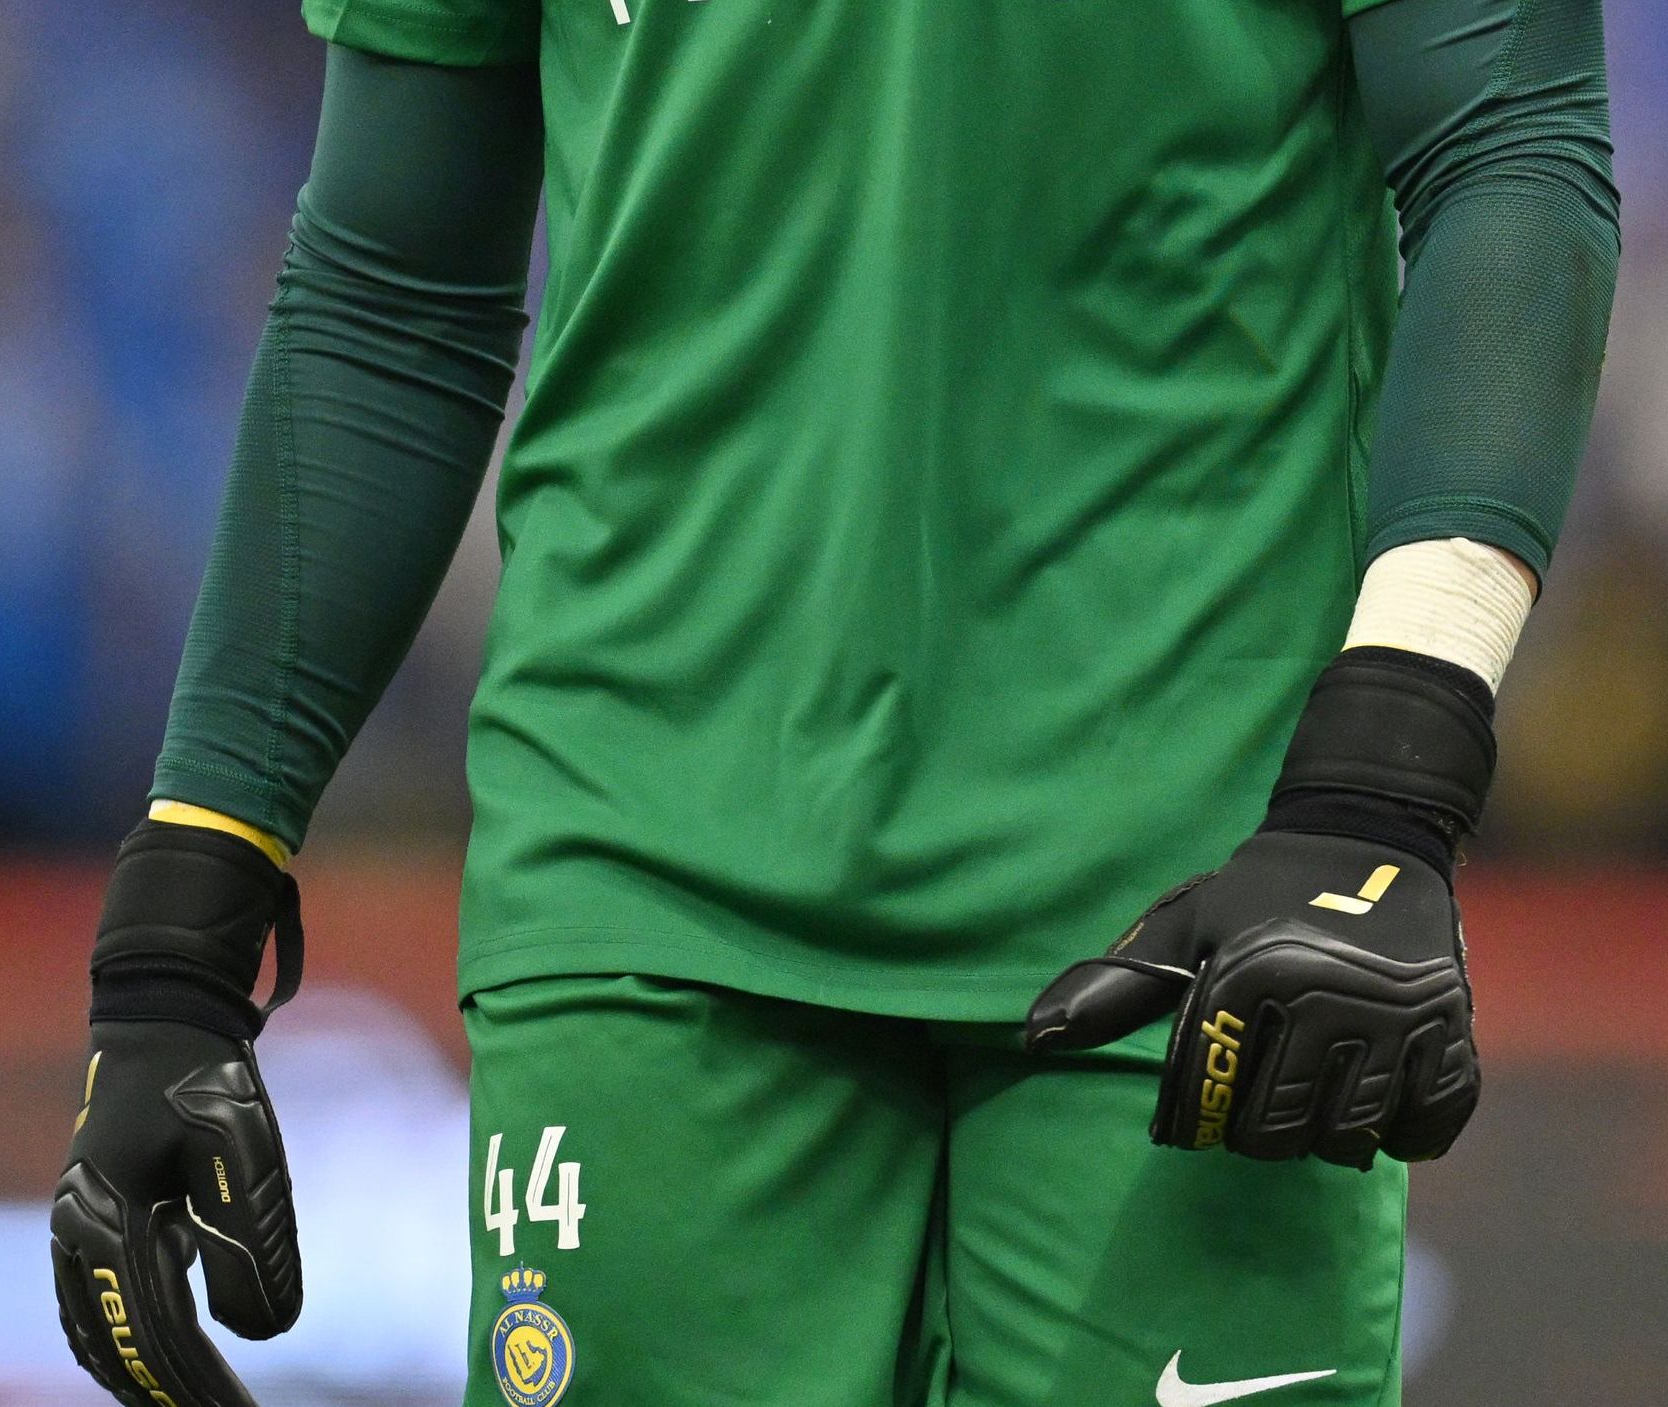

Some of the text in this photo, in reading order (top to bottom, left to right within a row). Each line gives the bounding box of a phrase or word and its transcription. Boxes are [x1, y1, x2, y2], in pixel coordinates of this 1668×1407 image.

[213, 1156, 231, 1203] DUOTECH
[484, 1125, 587, 1257] 44
[499, 1310, 559, 1341] AL NASSR
[502, 1376, 557, 1405] FOOTBALL CLUB
